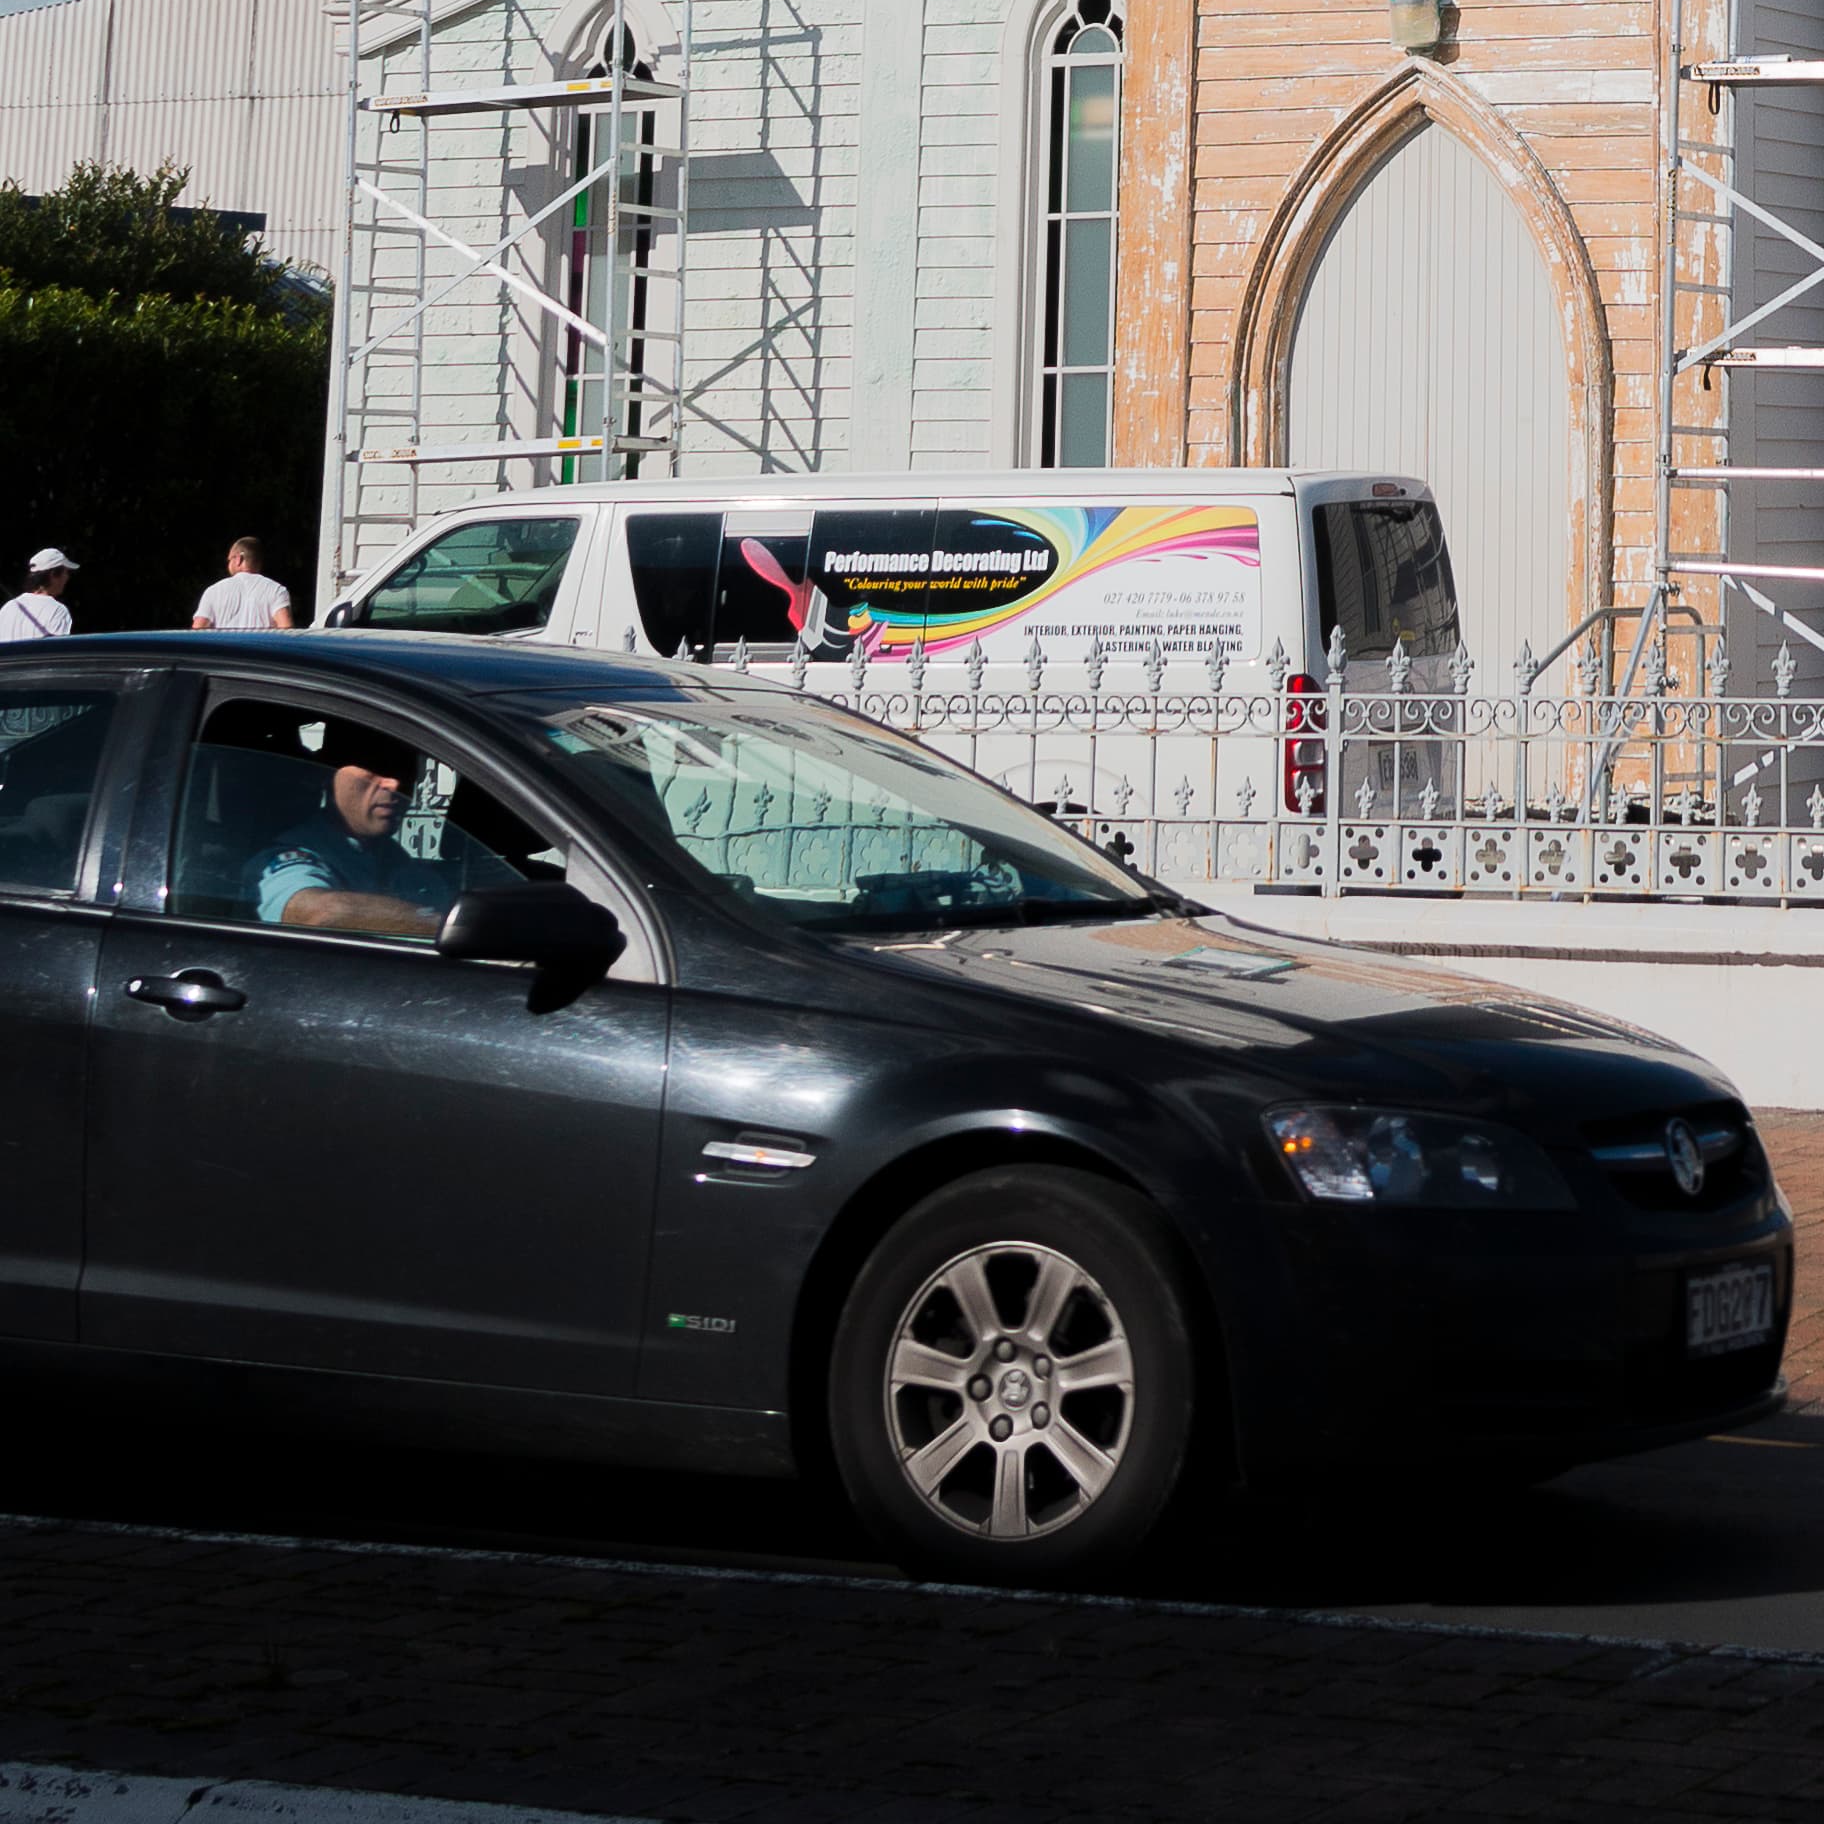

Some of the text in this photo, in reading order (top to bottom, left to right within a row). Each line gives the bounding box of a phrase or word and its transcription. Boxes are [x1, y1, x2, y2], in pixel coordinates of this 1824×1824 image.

[824, 549, 1049, 574] Performance Decorating Ltd
[900, 580, 927, 593] your
[929, 577, 961, 590] world
[963, 576, 988, 590] with
[1103, 592, 1124, 604] 027
[1126, 592, 1145, 604] 420
[1216, 591, 1230, 603] 97
[1167, 624, 1196, 635] PAPER
[1162, 641, 1193, 652] WATER
[1196, 640, 1243, 652] BLATING
